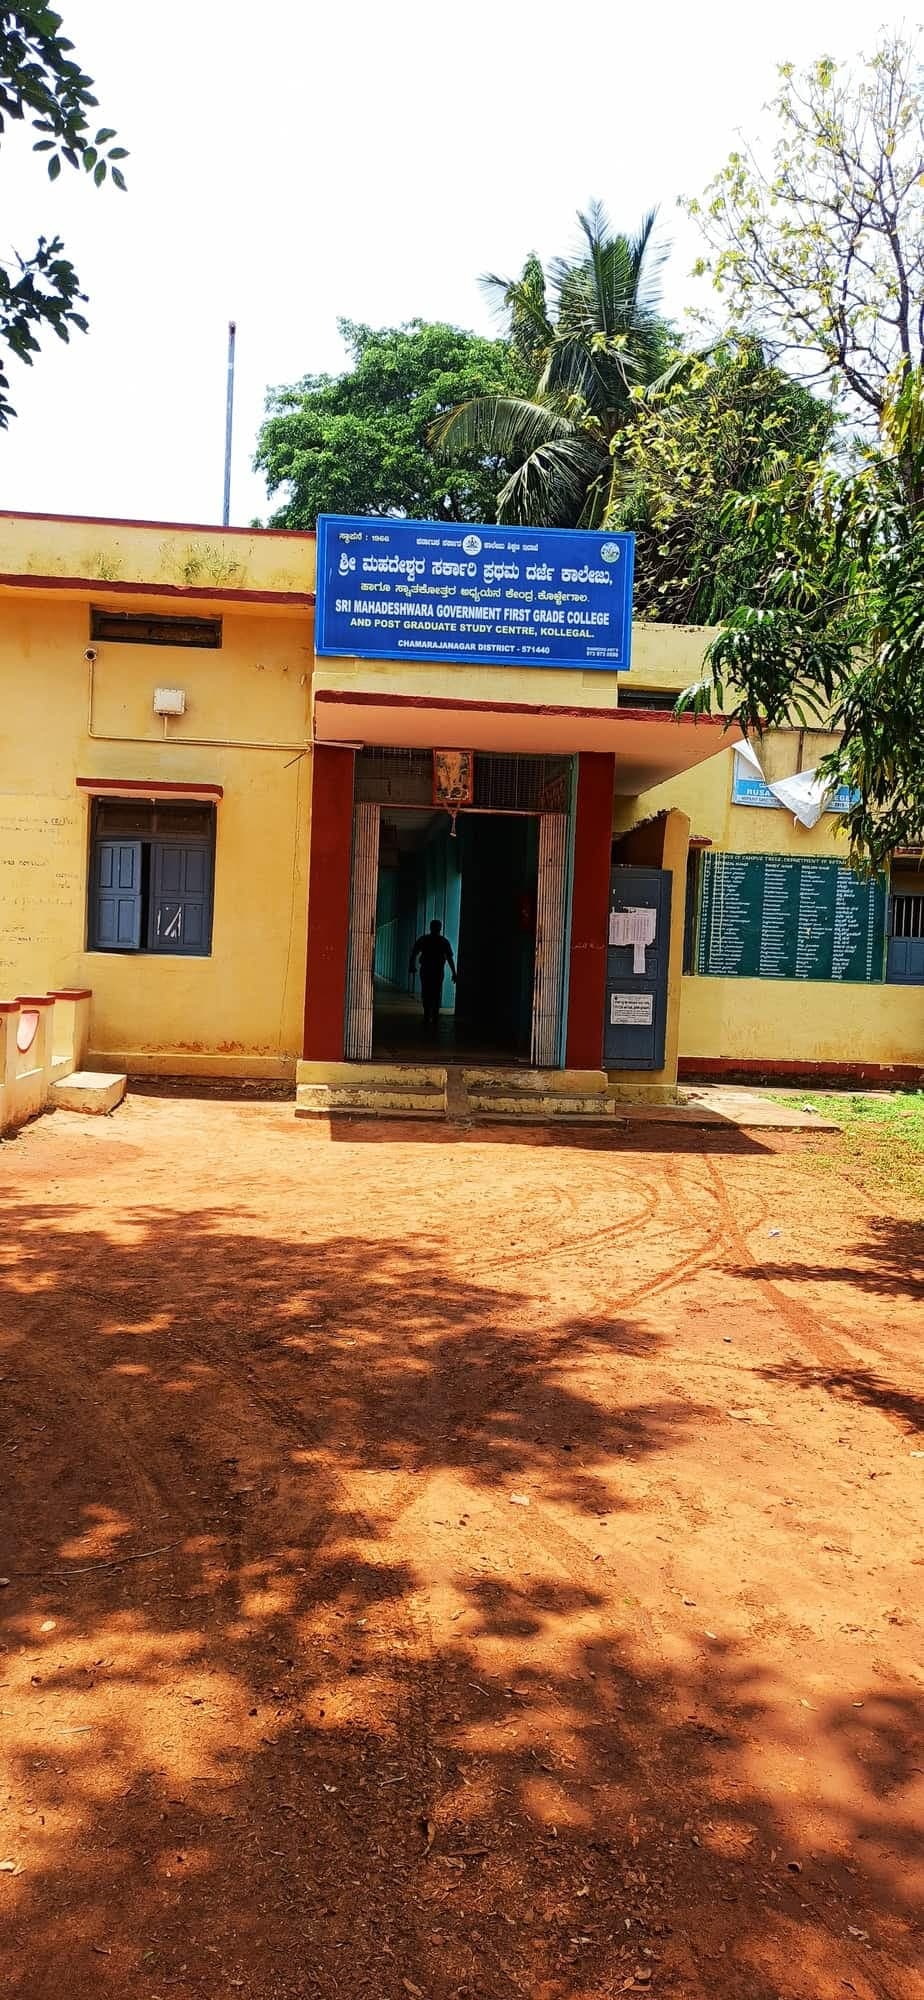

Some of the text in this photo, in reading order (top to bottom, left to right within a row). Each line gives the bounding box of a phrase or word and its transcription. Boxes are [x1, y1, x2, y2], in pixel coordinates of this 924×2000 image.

[338, 552, 356, 576] ಶ್ರೀ
[431, 557, 477, 577] ಸರ್ಕಾರಿ
[483, 561, 520, 584] ಪ್ರಥಮ
[525, 562, 555, 581] ದರ್ಜೆ
[360, 581, 391, 592] ಹಾಗೂ
[335, 599, 609, 625] SRI MAHADESHWARA GOVERNMENT FIRST GRADE COLLEGE
[350, 617, 595, 638] AND POST GRADUATE STUDY CENTRE, KOLLEGAL.
[398, 639, 476, 651] CHAMARAJANAGAR
[478, 643, 515, 653] DISTRICT
[521, 645, 550, 654] 571440
[746, 788, 770, 796] RUSA
